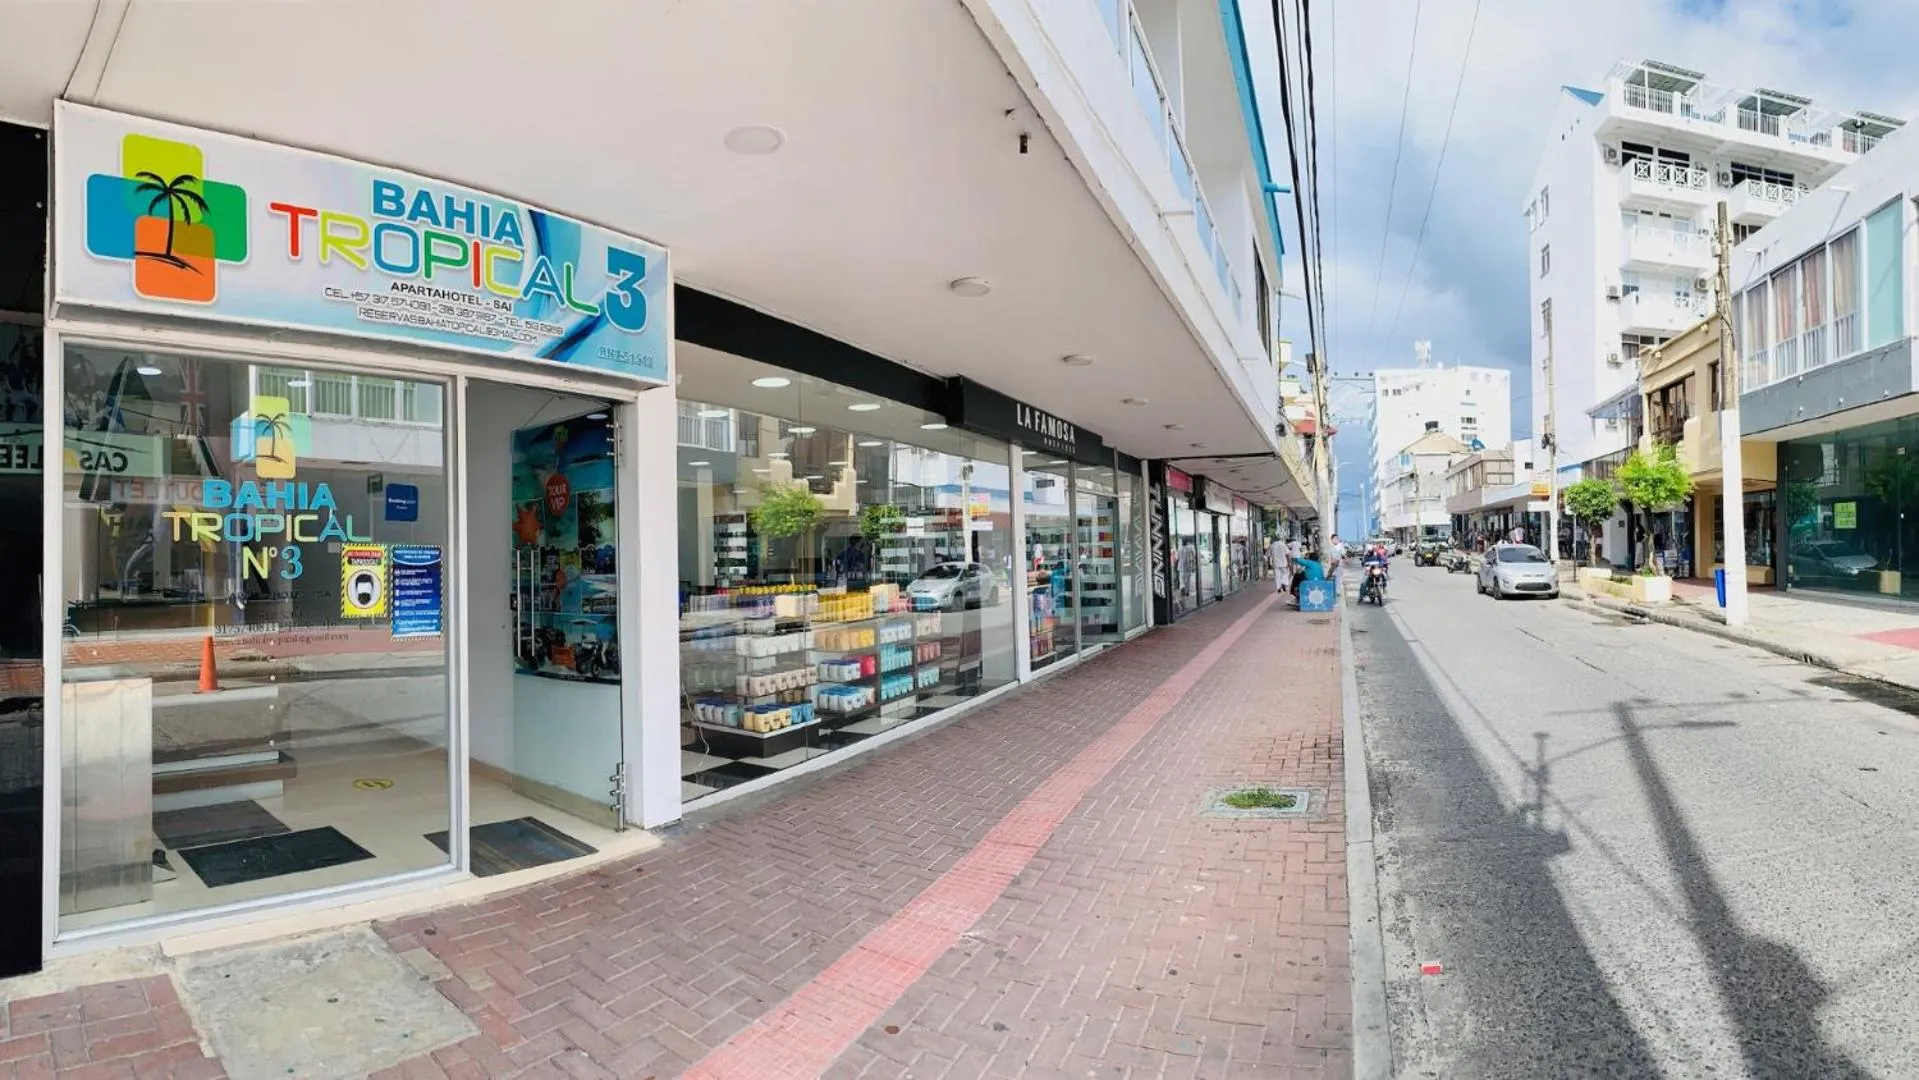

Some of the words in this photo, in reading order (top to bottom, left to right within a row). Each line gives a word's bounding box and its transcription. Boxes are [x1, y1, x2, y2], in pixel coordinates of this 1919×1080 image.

[372, 179, 526, 248] BAHIA
[269, 201, 599, 315] TROPICAL
[605, 245, 648, 332] 3
[390, 281, 484, 306] APARTAHOTEL
[492, 299, 513, 313] SAI
[1016, 402, 1032, 430] LA
[1034, 410, 1076, 445] FAMOSA
[202, 479, 338, 511] BAHIA
[161, 510, 373, 543] TROPICAL
[1149, 482, 1167, 599] TUNNING
